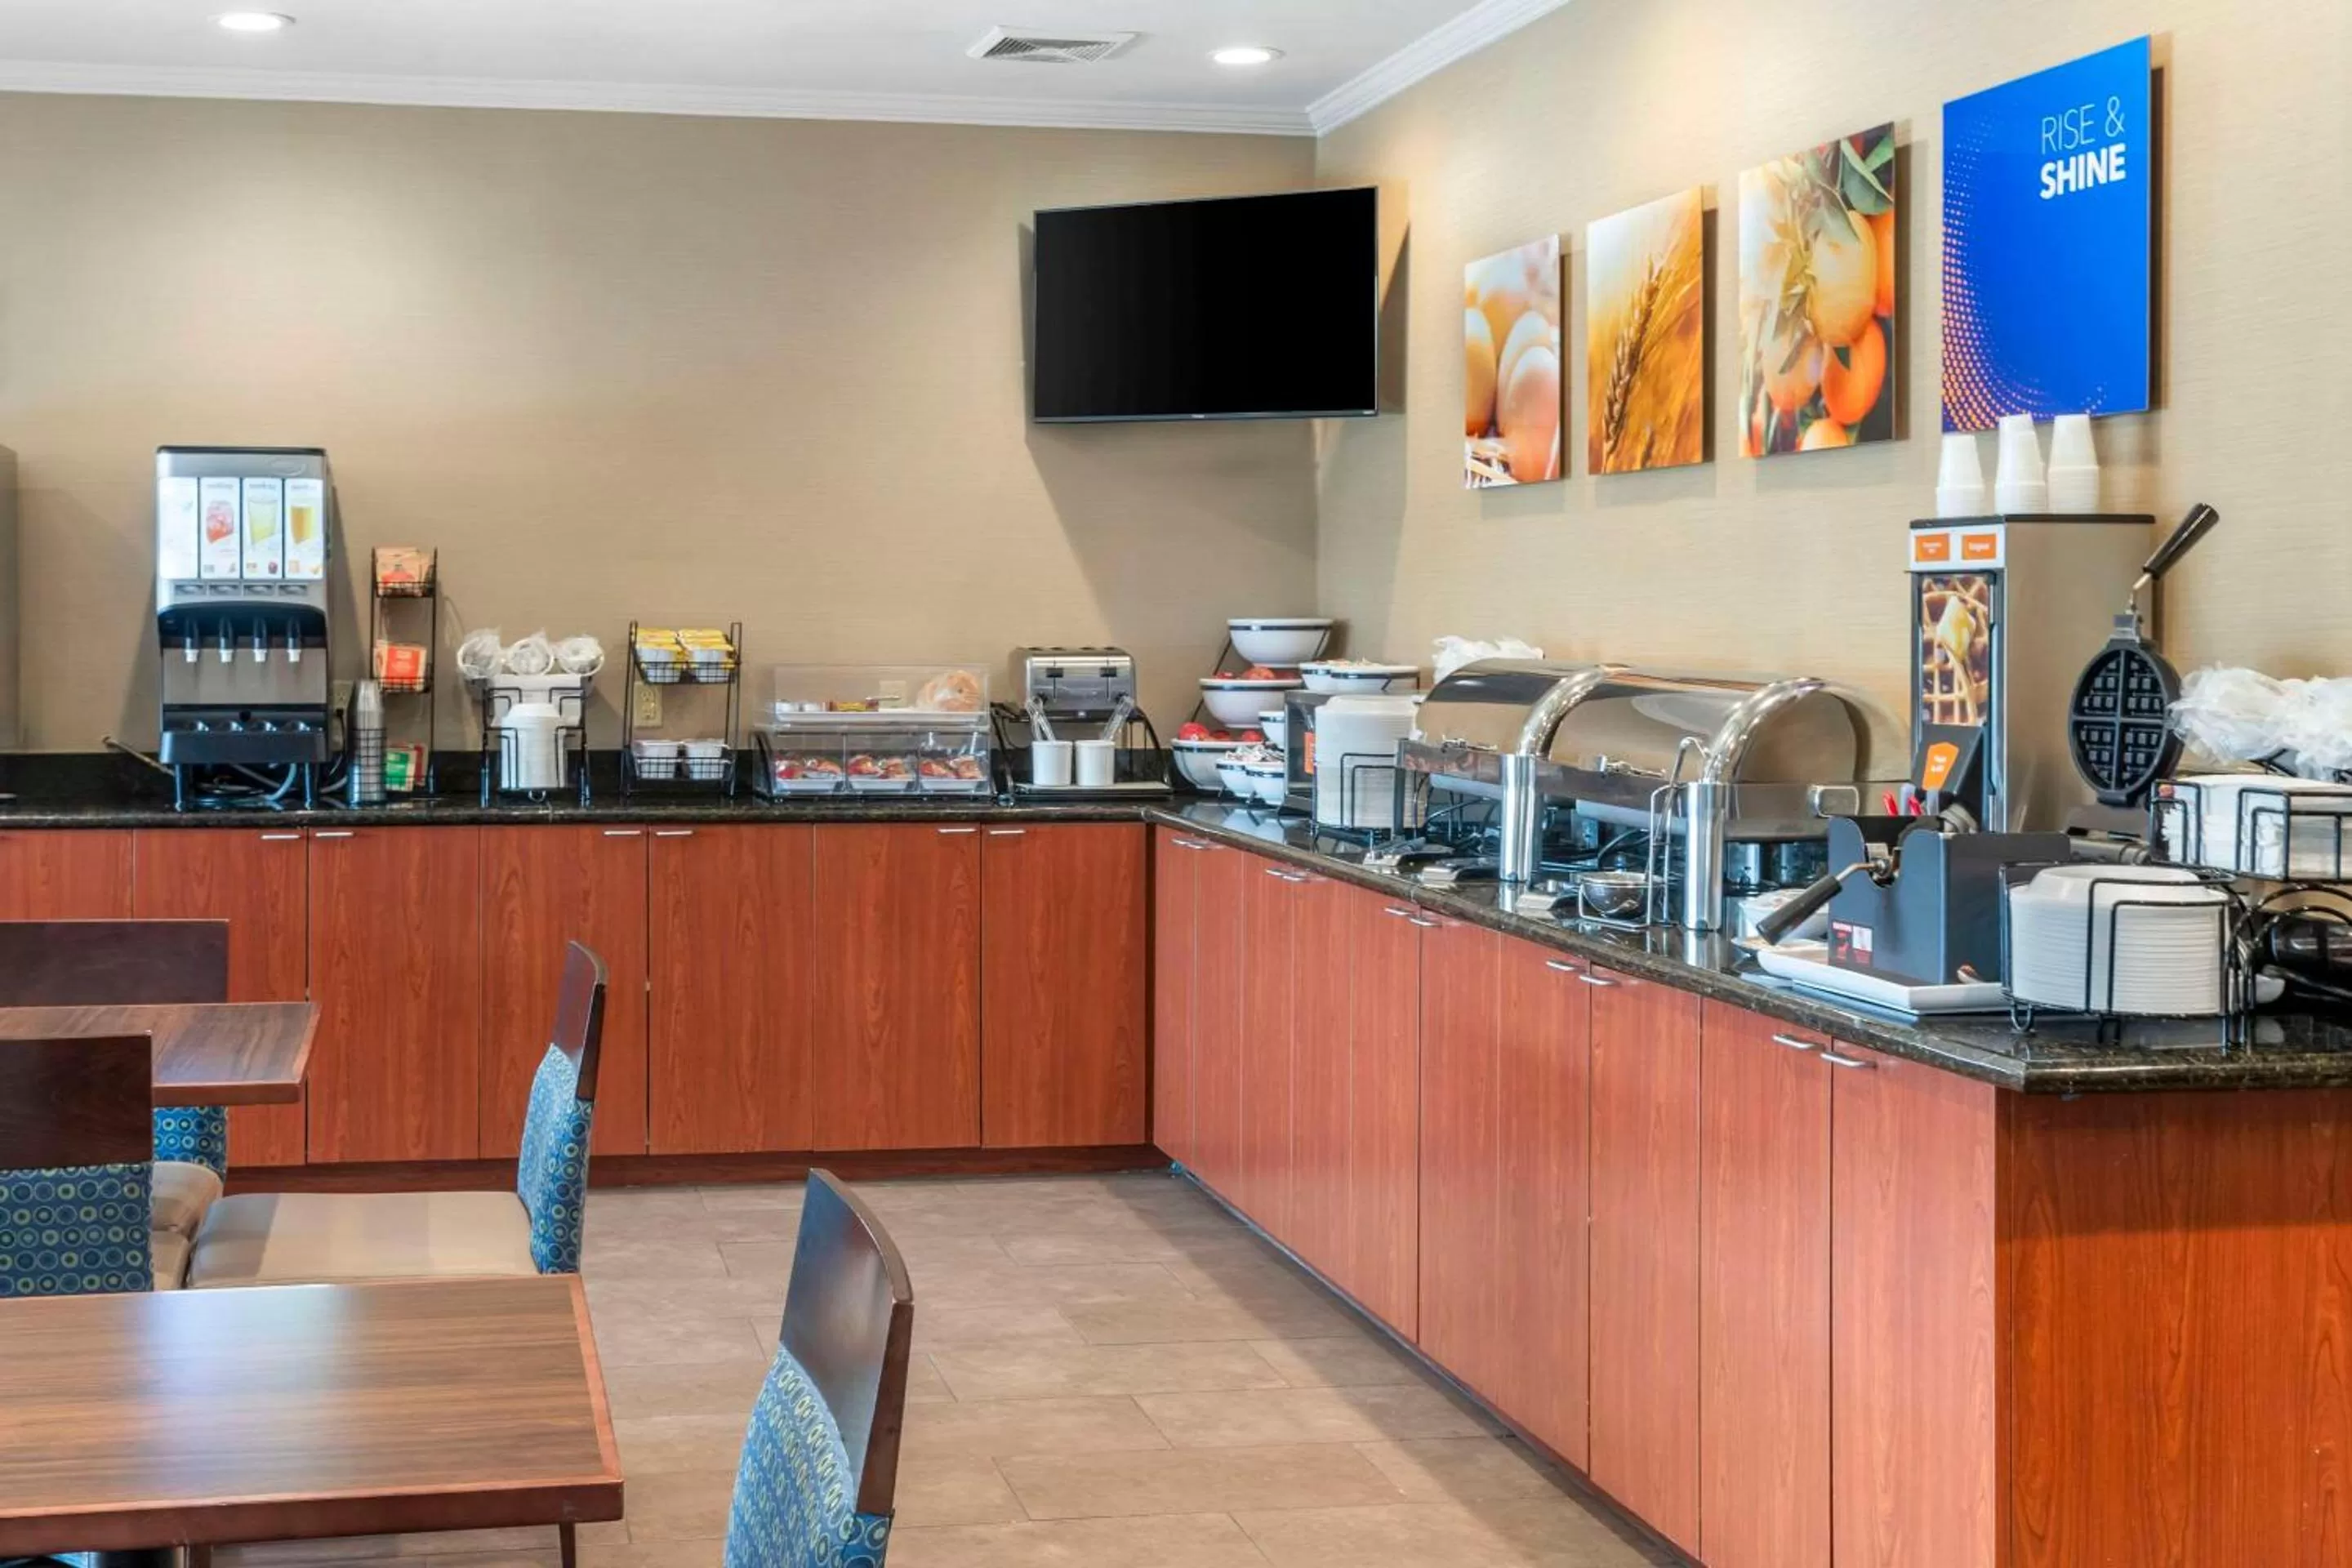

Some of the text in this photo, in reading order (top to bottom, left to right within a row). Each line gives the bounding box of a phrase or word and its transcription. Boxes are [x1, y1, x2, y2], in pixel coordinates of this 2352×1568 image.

[2042, 96, 2125, 155] RISE &
[2040, 142, 2127, 200] SHINE
